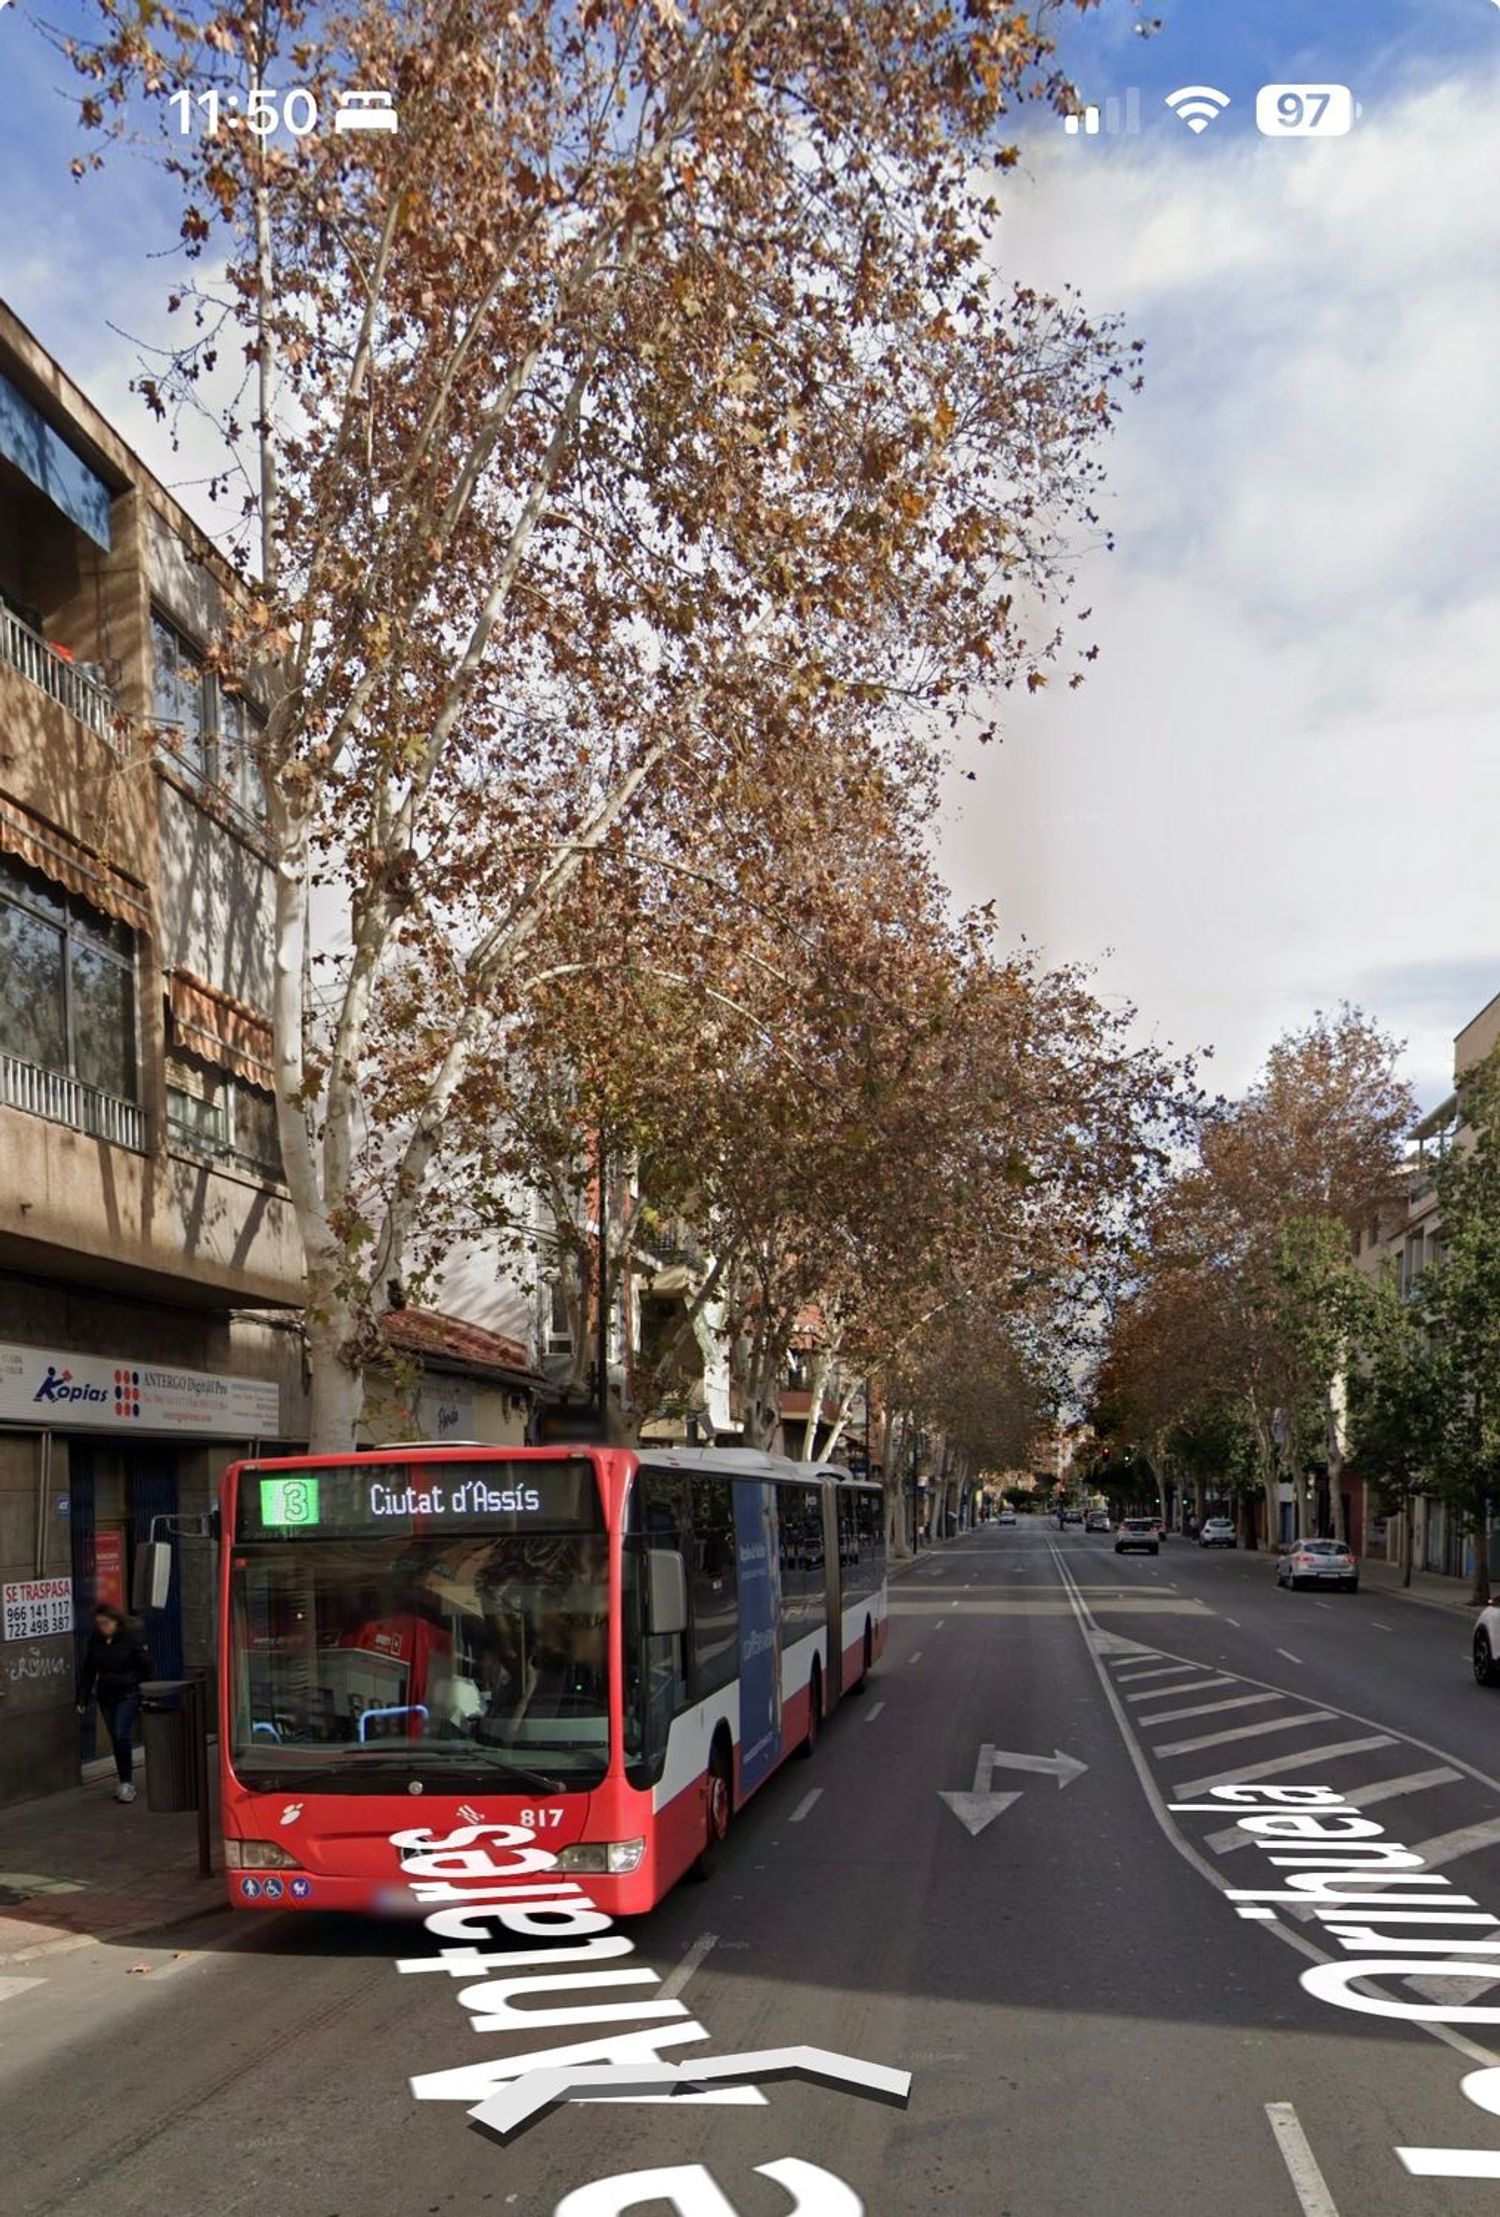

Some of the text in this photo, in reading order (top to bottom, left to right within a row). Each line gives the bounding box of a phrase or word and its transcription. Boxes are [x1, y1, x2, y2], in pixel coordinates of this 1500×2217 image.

[33, 1366, 108, 1404] Kopias
[282, 1480, 309, 1523] 3
[370, 1483, 445, 1515] Ciutat
[6, 1580, 71, 1604] SE TRASPASA
[7, 1600, 70, 1623] 966 141 117
[8, 1616, 70, 1638] 722 498 387
[519, 1808, 565, 1829] 817
